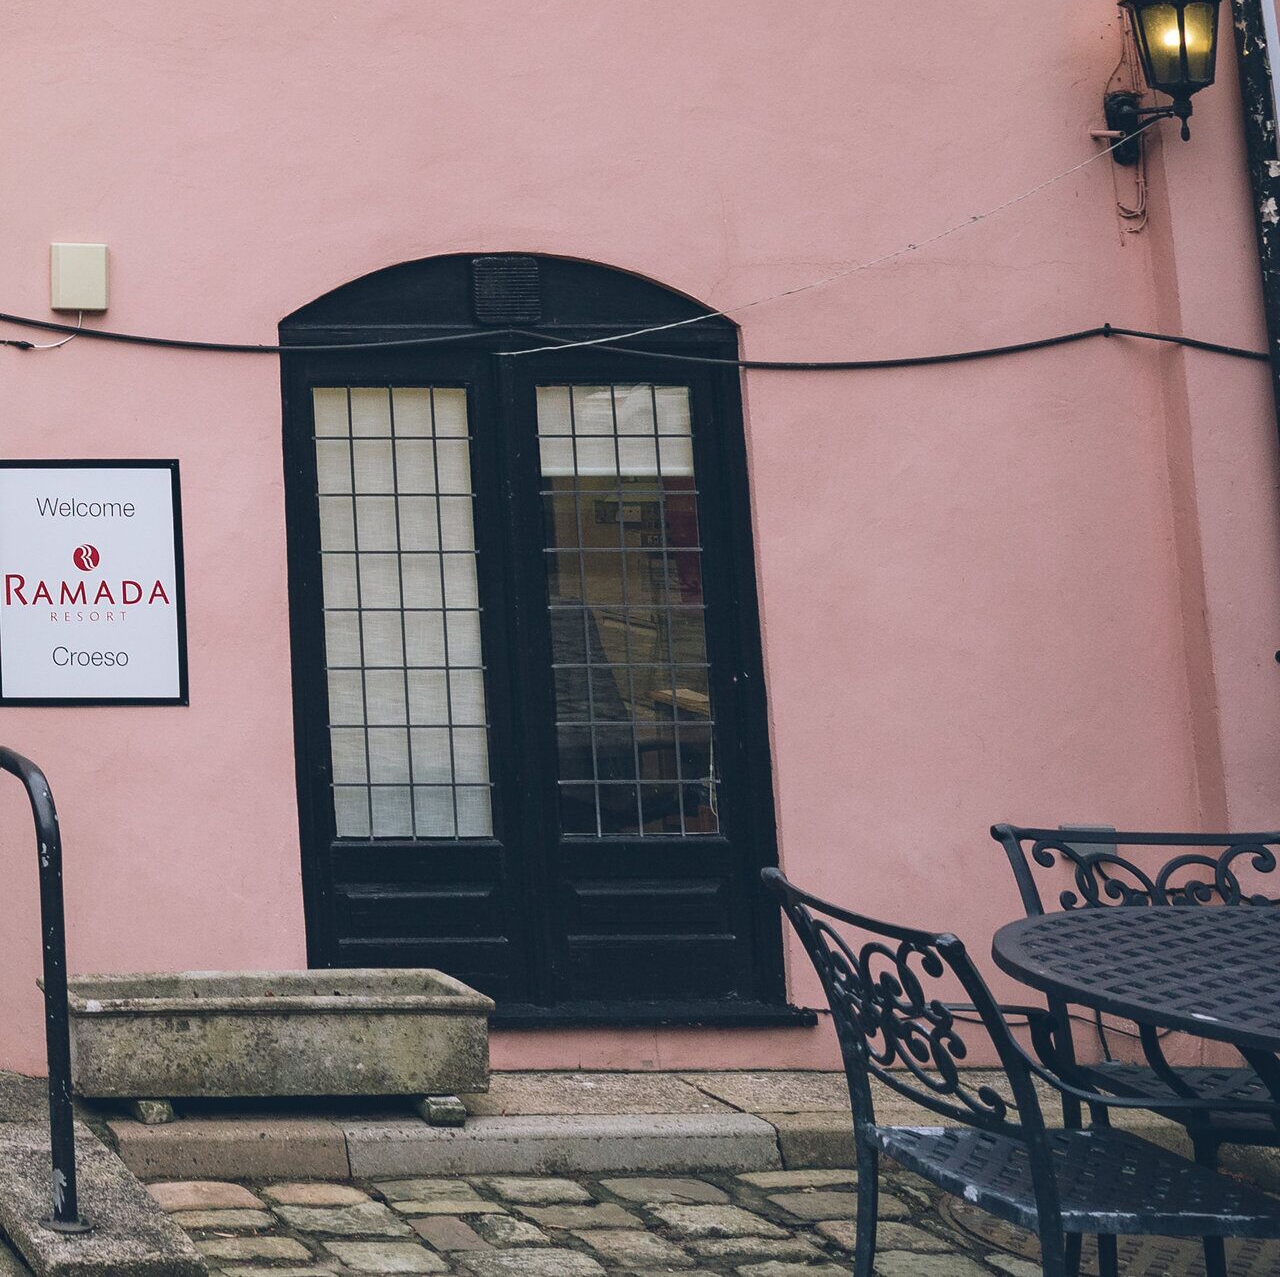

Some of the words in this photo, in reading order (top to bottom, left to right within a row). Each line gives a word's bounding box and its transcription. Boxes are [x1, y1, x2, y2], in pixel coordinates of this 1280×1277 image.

[36, 497, 136, 518] Welcome
[4, 573, 171, 606] RAMADA
[50, 611, 127, 622] RESORT
[52, 646, 129, 667] Croeso
